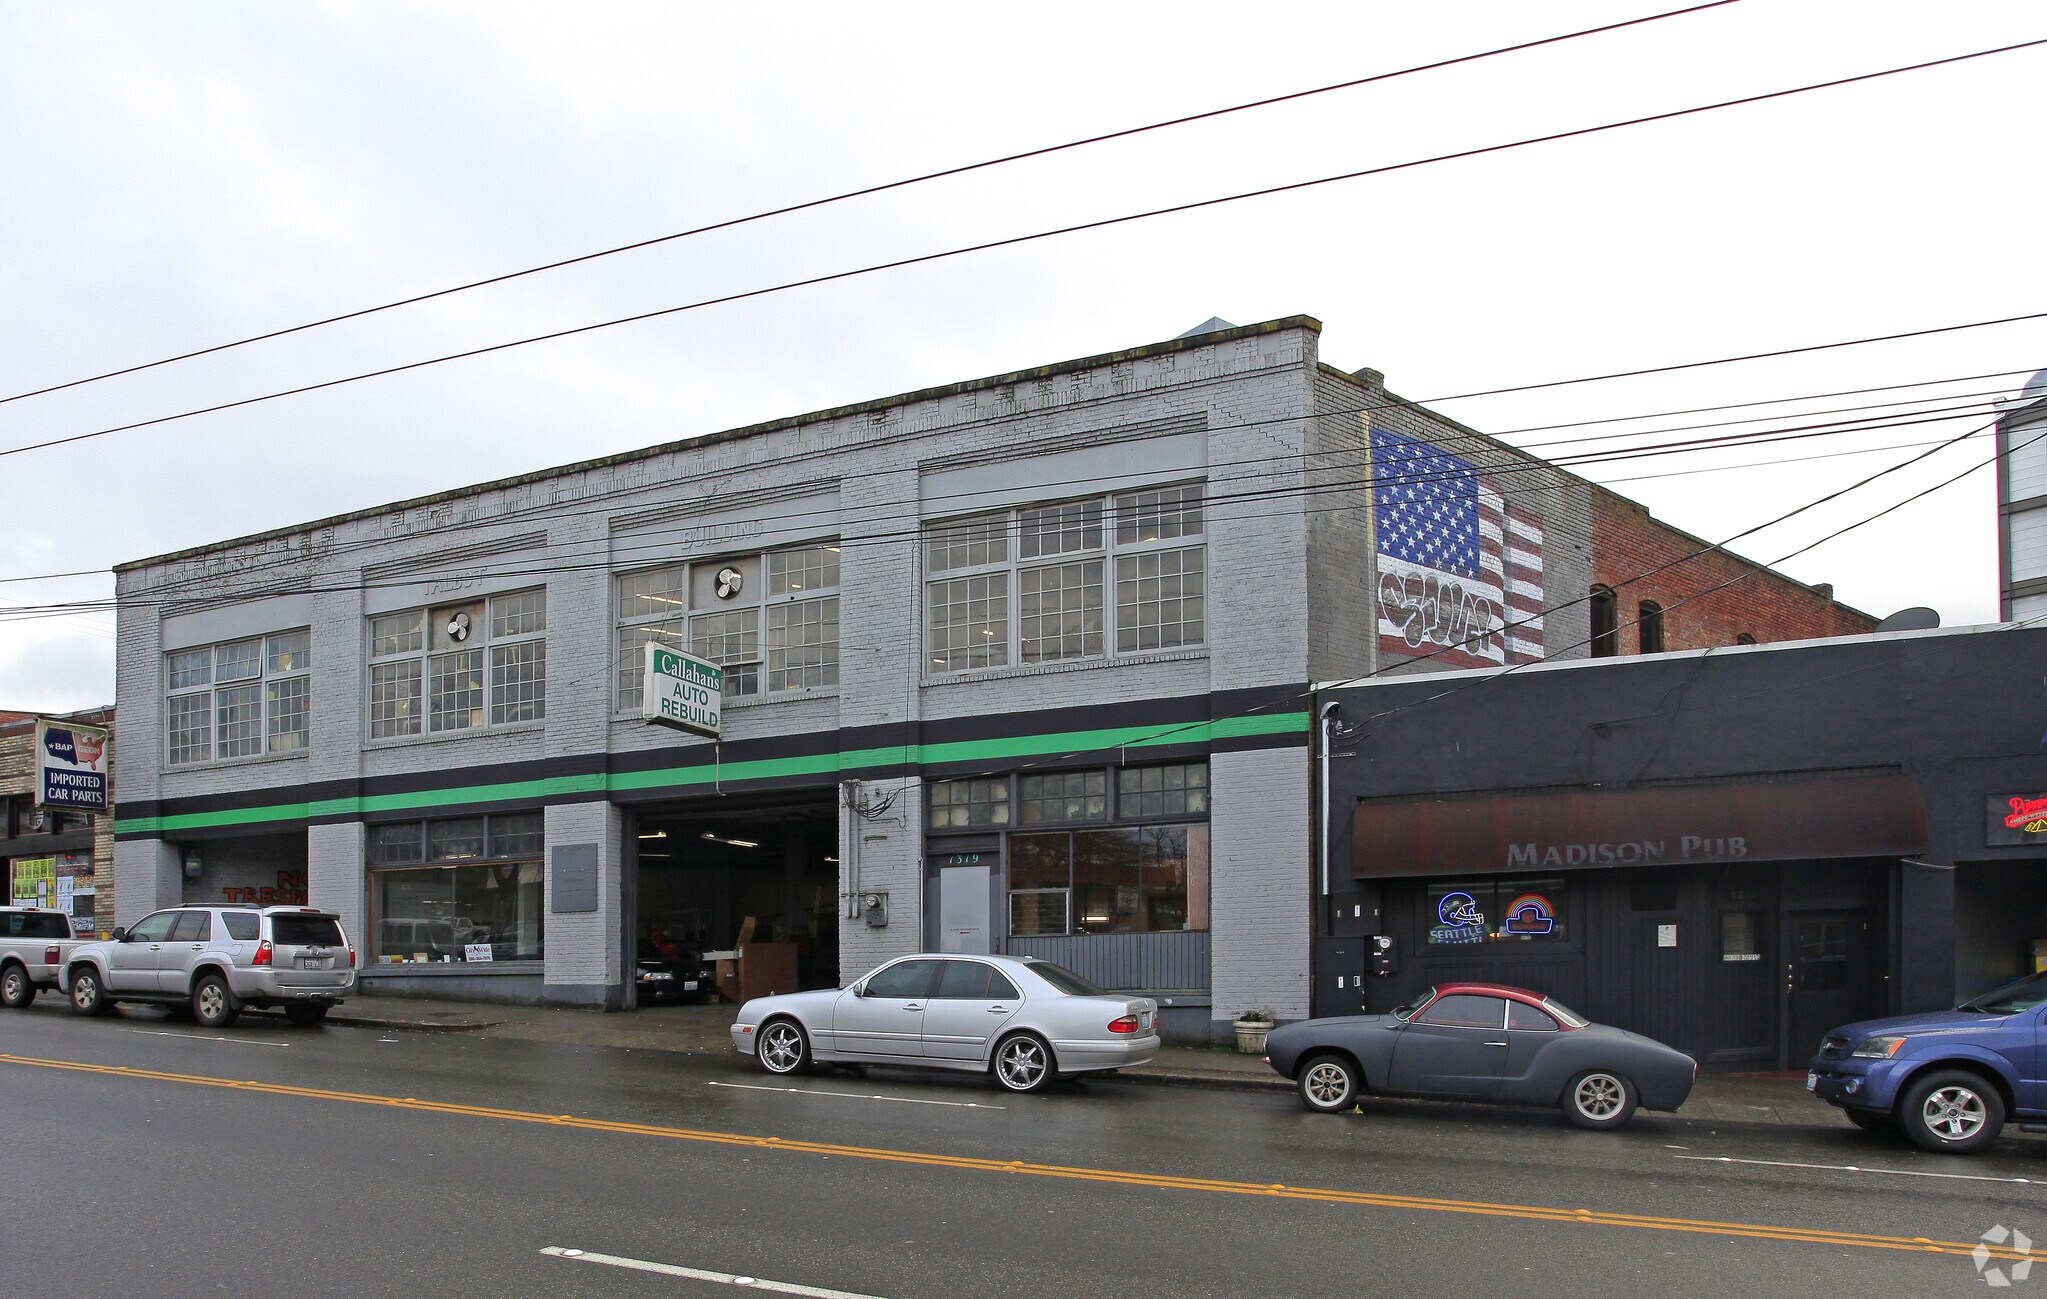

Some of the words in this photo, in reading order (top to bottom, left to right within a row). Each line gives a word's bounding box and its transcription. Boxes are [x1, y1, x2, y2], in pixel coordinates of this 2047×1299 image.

[681, 520, 764, 550] BUILDING
[425, 566, 488, 595] TALBOT
[673, 682, 709, 706] AUTO
[661, 697, 718, 728] REBUILD
[55, 742, 73, 751] BAP
[78, 745, 100, 755] GEON
[50, 772, 100, 788] IMPORTED
[48, 787, 69, 800] CAR
[72, 789, 103, 803] PARTS
[1430, 925, 1483, 939] SEATTLE
